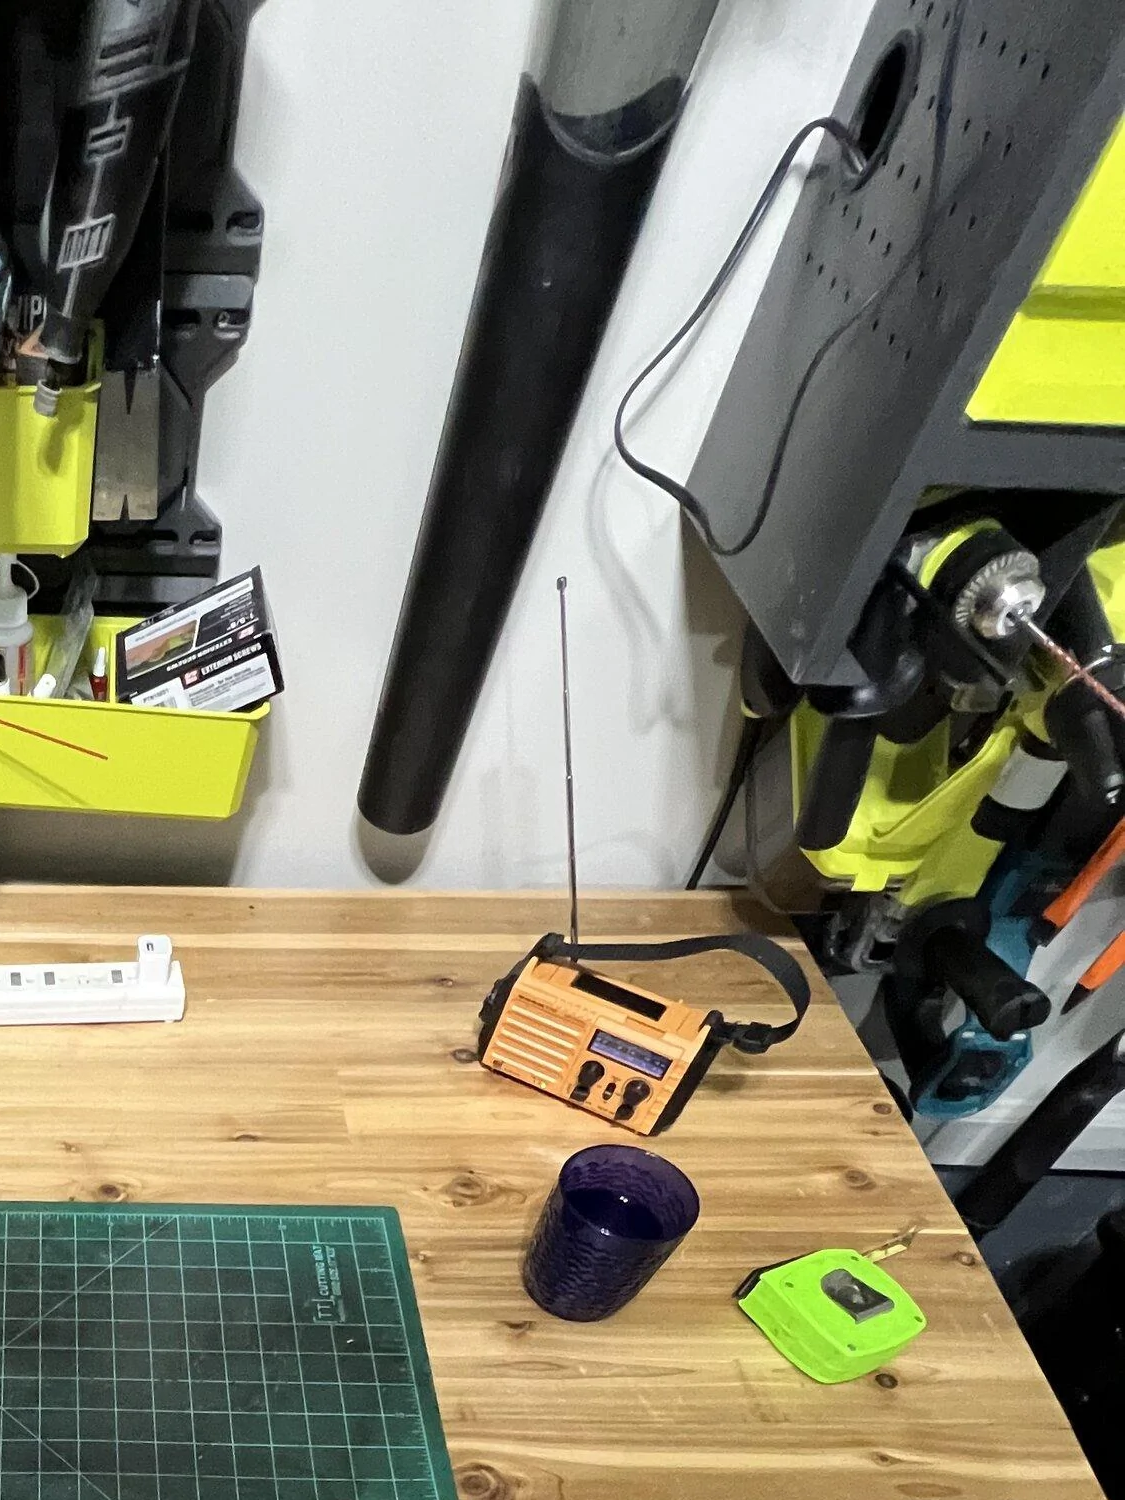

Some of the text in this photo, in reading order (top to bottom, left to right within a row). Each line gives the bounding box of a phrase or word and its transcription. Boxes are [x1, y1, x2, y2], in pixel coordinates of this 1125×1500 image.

[201, 642, 262, 676] EXTERIOR SCREWS
[312, 1245, 329, 1296] CUTTING MAT
